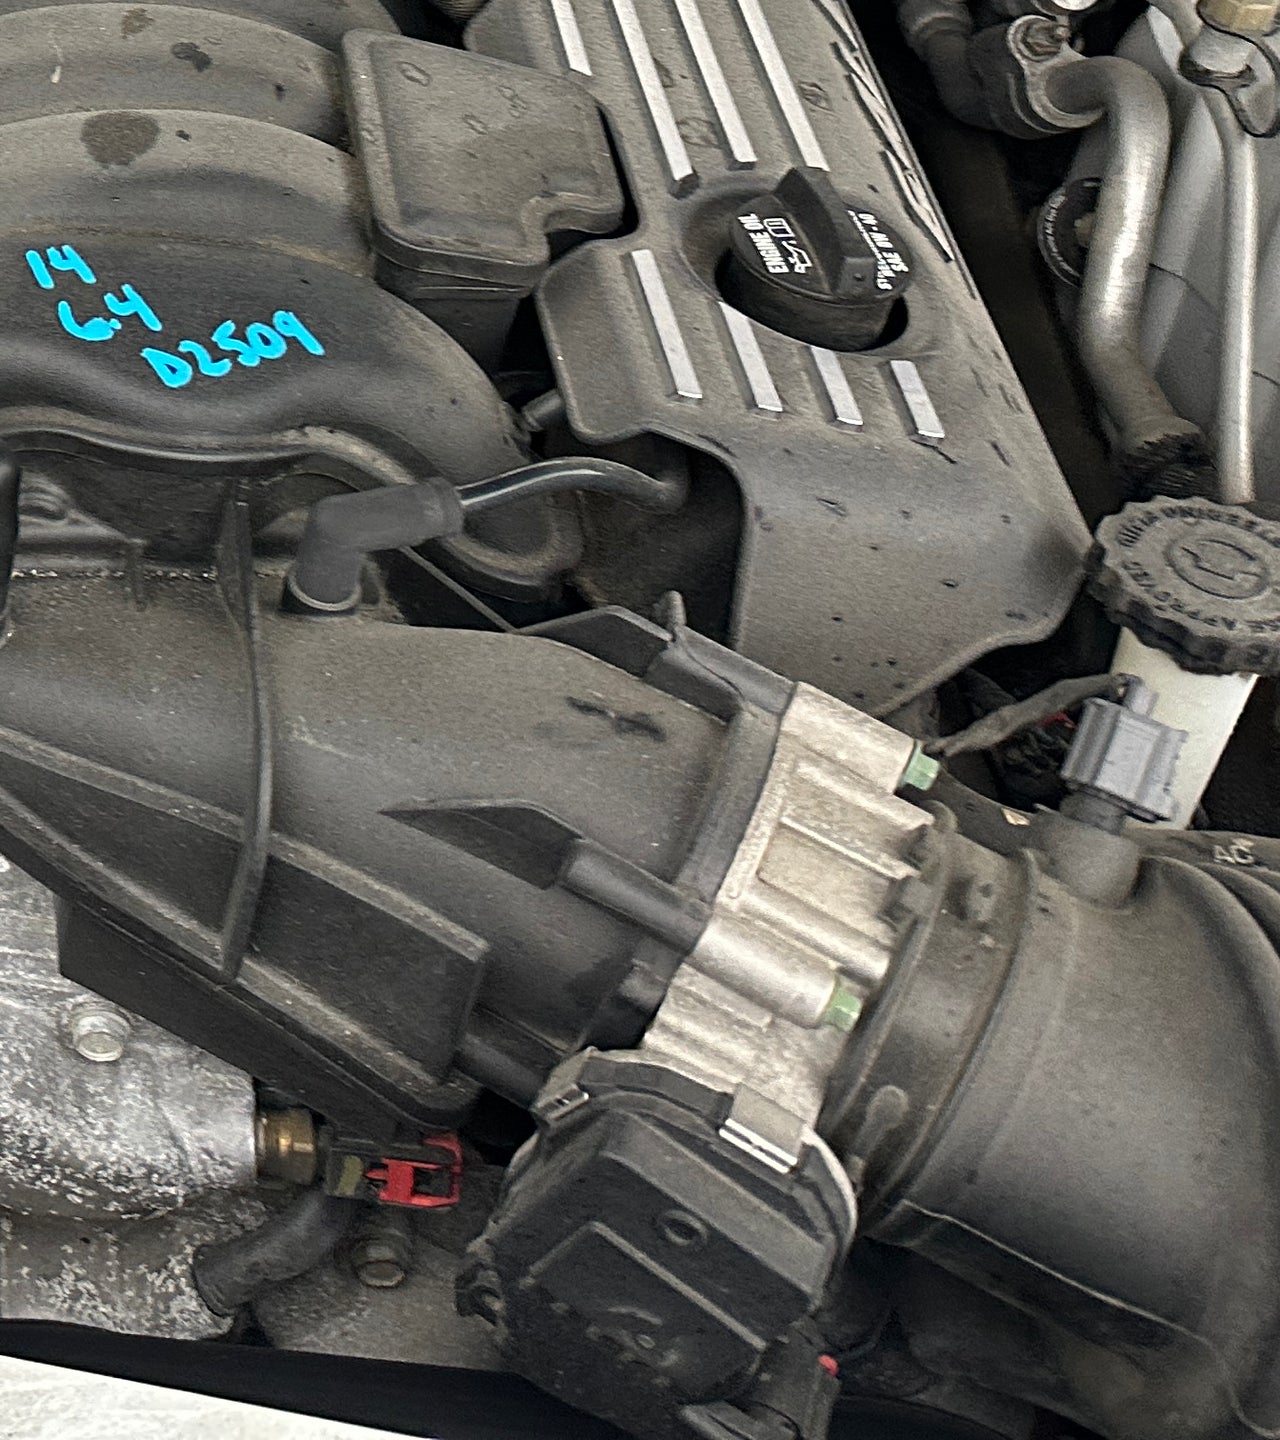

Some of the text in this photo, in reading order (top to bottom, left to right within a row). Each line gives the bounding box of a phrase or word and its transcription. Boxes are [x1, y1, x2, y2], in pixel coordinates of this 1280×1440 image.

[26, 245, 96, 288] 14
[738, 213, 789, 273] ENGINE OIL
[883, 252, 909, 272] SAE
[142, 310, 325, 388] D2509
